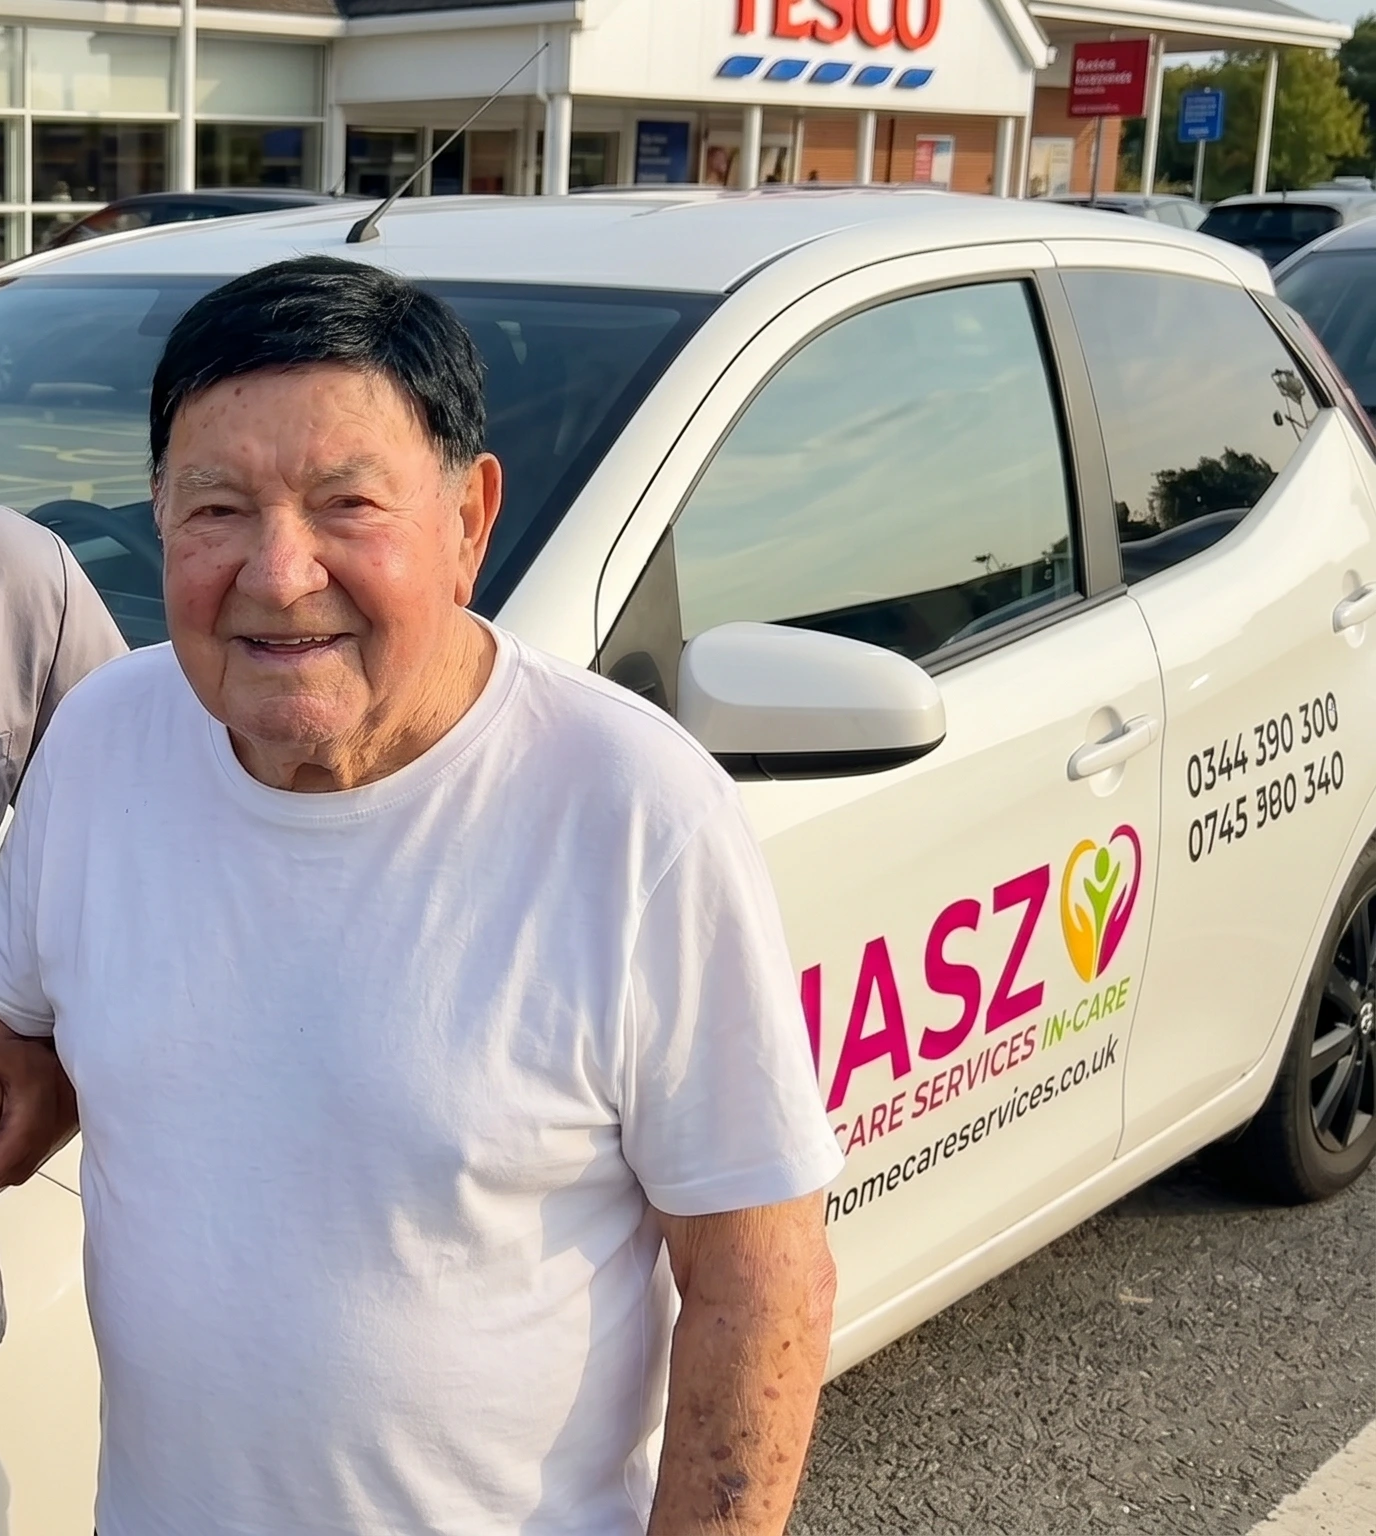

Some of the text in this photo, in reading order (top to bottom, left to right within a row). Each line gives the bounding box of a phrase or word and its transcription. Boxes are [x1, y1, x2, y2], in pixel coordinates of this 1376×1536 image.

[1187, 691, 1338, 798] 0344 390 300
[1188, 795, 1248, 863] 0745
[1304, 751, 1344, 804] 340
[911, 1025, 1037, 1119] SERVICES
[1041, 977, 1131, 1050] IN-CARE
[824, 1033, 1119, 1226] homecareservices.co.uk
